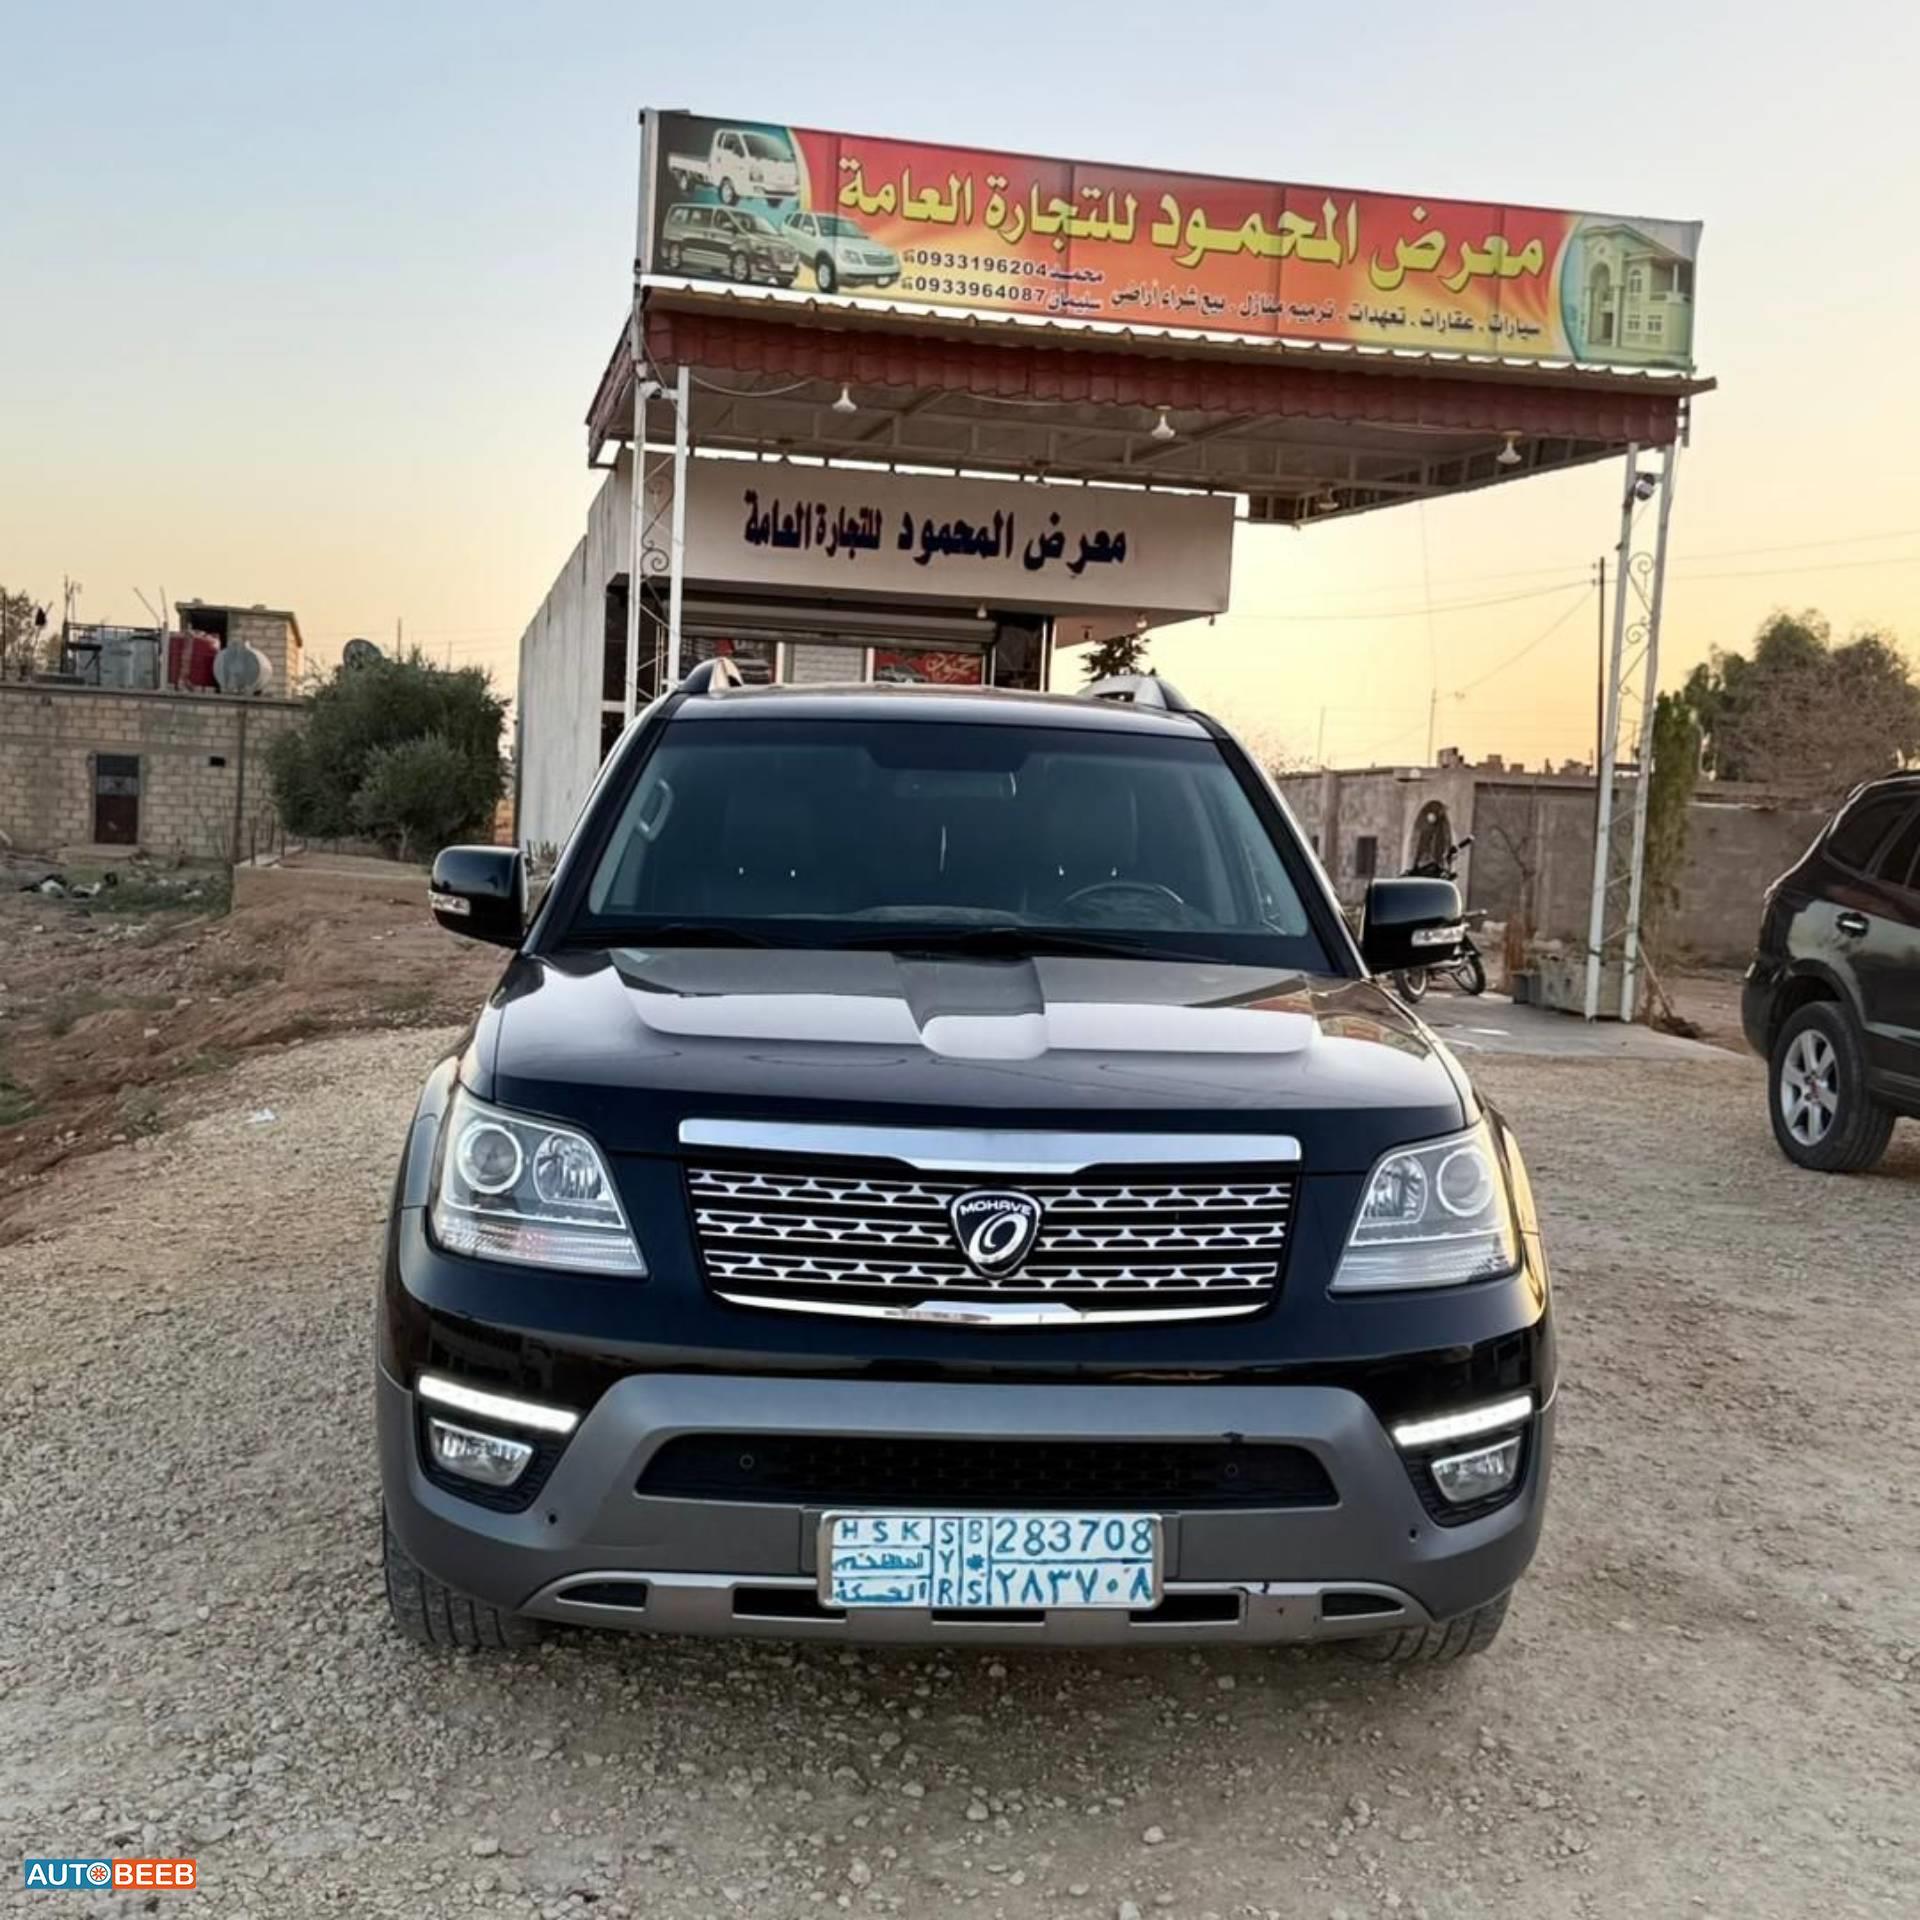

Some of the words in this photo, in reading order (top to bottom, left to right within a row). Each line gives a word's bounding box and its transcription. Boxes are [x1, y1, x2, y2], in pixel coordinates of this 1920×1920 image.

[838, 157, 973, 225] العامة
[983, 174, 1137, 250] للتجارة
[1151, 194, 1359, 269] المحمود
[1370, 206, 1544, 294] معرض
[916, 249, 1047, 277] 0933196204
[914, 276, 1046, 303] 0933964087
[1200, 292, 1226, 316] بيع
[1238, 294, 1283, 318] منازل
[1347, 303, 1406, 331] تعهدات
[1418, 308, 1474, 333] عقارات
[1486, 313, 1541, 340] سيارات
[744, 489, 812, 550] العامة
[815, 503, 882, 560] للتجارة
[897, 508, 1014, 566] المحمود
[1023, 511, 1126, 575] معرض
[959, 1199, 1033, 1216] MOHAVE
[995, 1518, 1153, 1556] 283708
